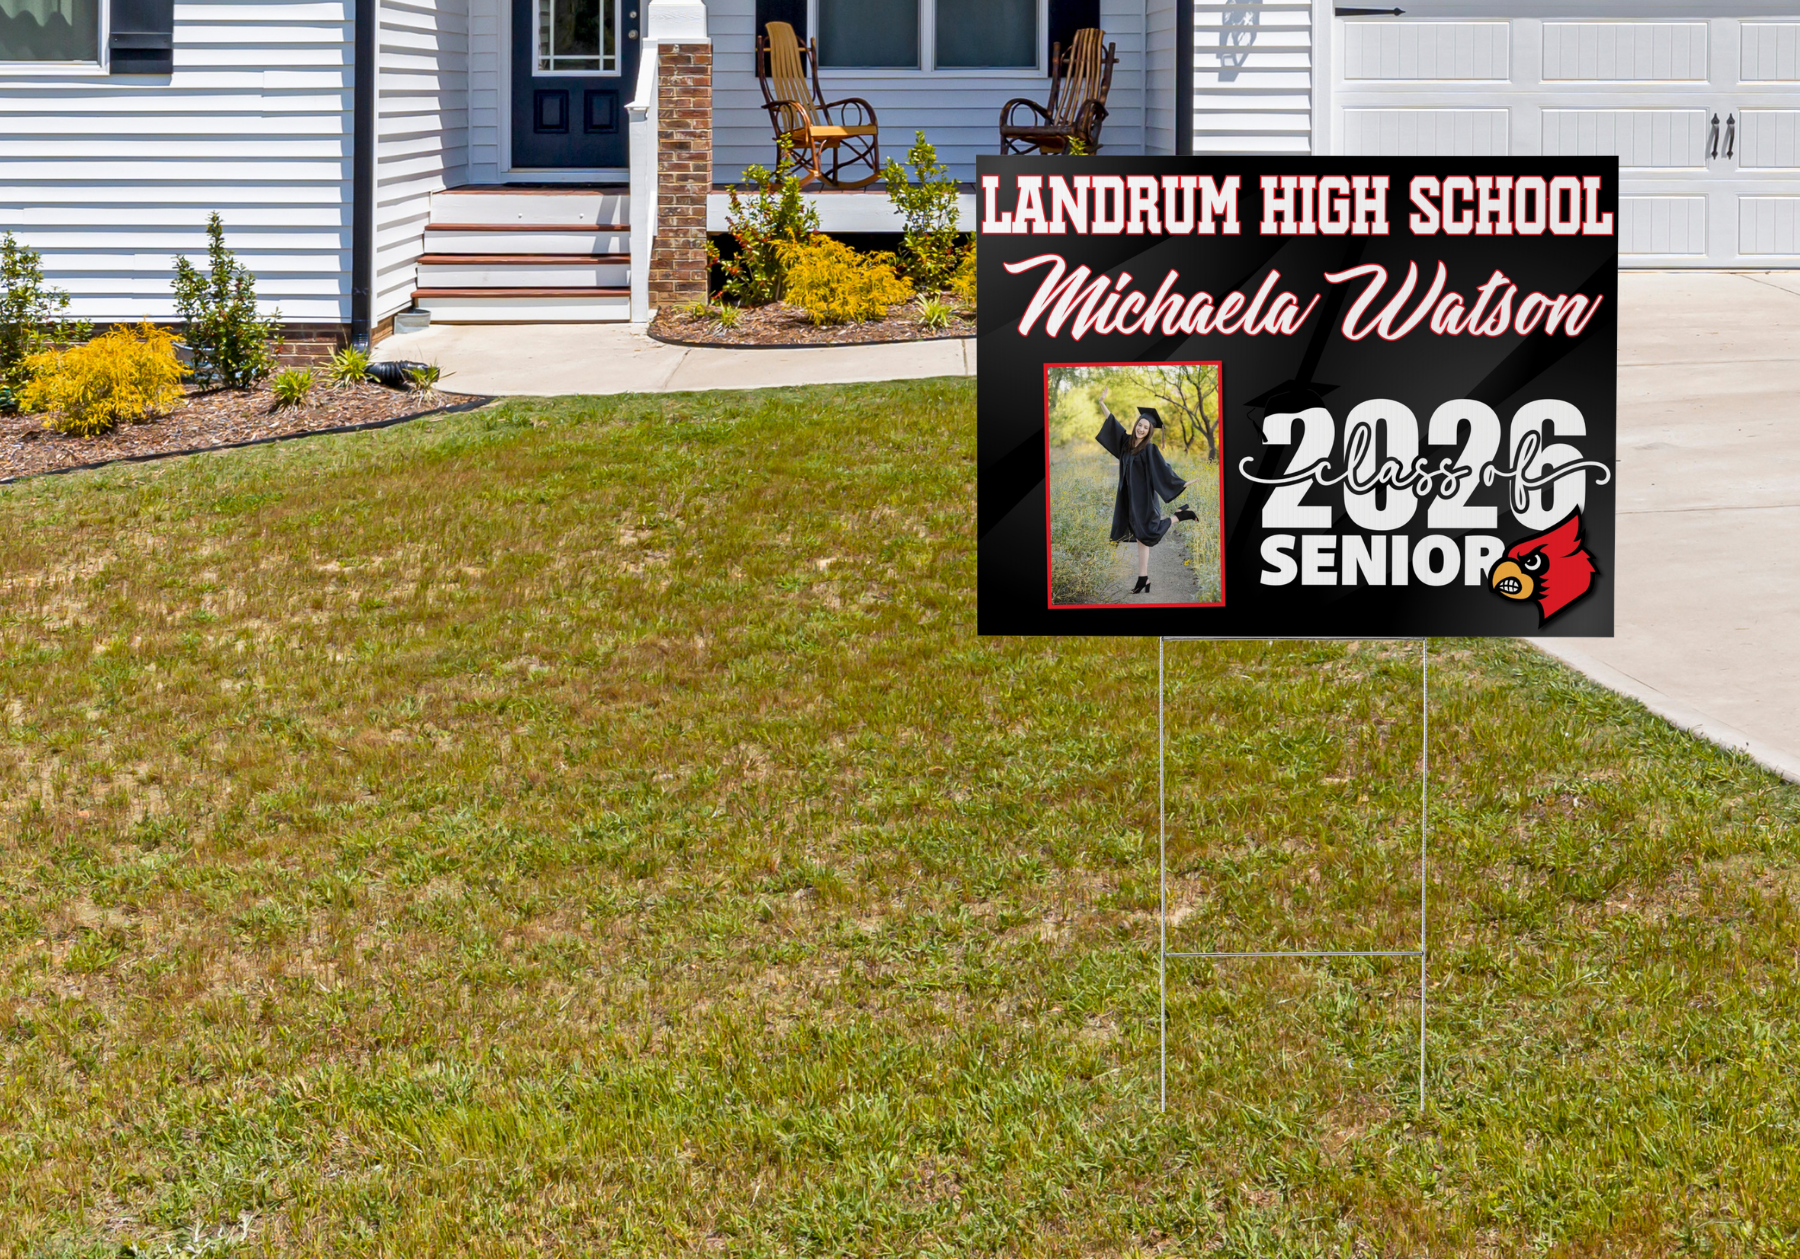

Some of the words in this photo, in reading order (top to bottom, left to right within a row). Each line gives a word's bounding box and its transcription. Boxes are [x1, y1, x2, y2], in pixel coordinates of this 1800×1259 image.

[981, 174, 1241, 235] LANDRUM
[1259, 174, 1390, 235] HIGH
[1409, 175, 1614, 235] SCHOOL
[1002, 253, 1321, 342] Michaela
[1324, 259, 1604, 341] Watson
[1238, 421, 1473, 497] class
[1479, 432, 1611, 511] of
[1261, 398, 1587, 531] 2026
[1259, 534, 1507, 587] SENIOR
